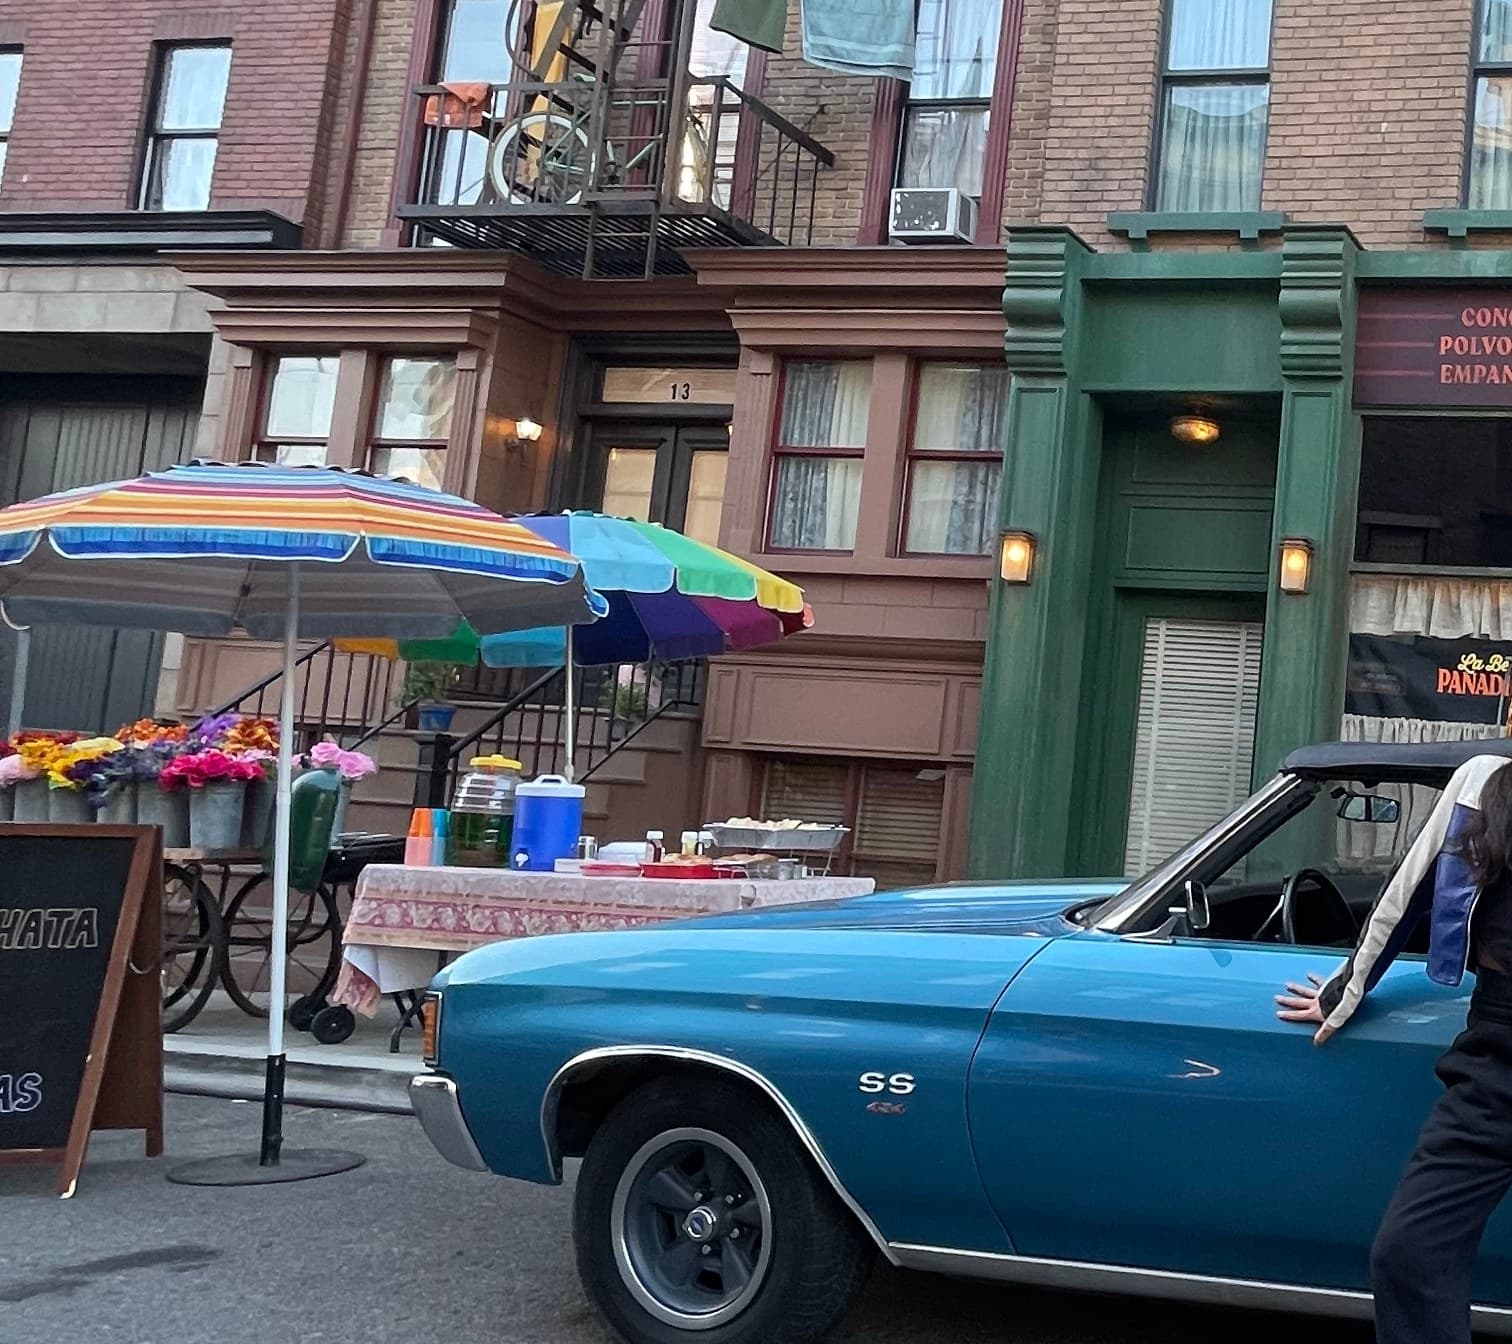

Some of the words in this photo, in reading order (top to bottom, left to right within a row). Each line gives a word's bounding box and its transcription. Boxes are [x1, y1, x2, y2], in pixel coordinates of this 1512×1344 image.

[671, 382, 691, 400] 13
[1457, 653, 1485, 675] La
[859, 1071, 916, 1095] SS
